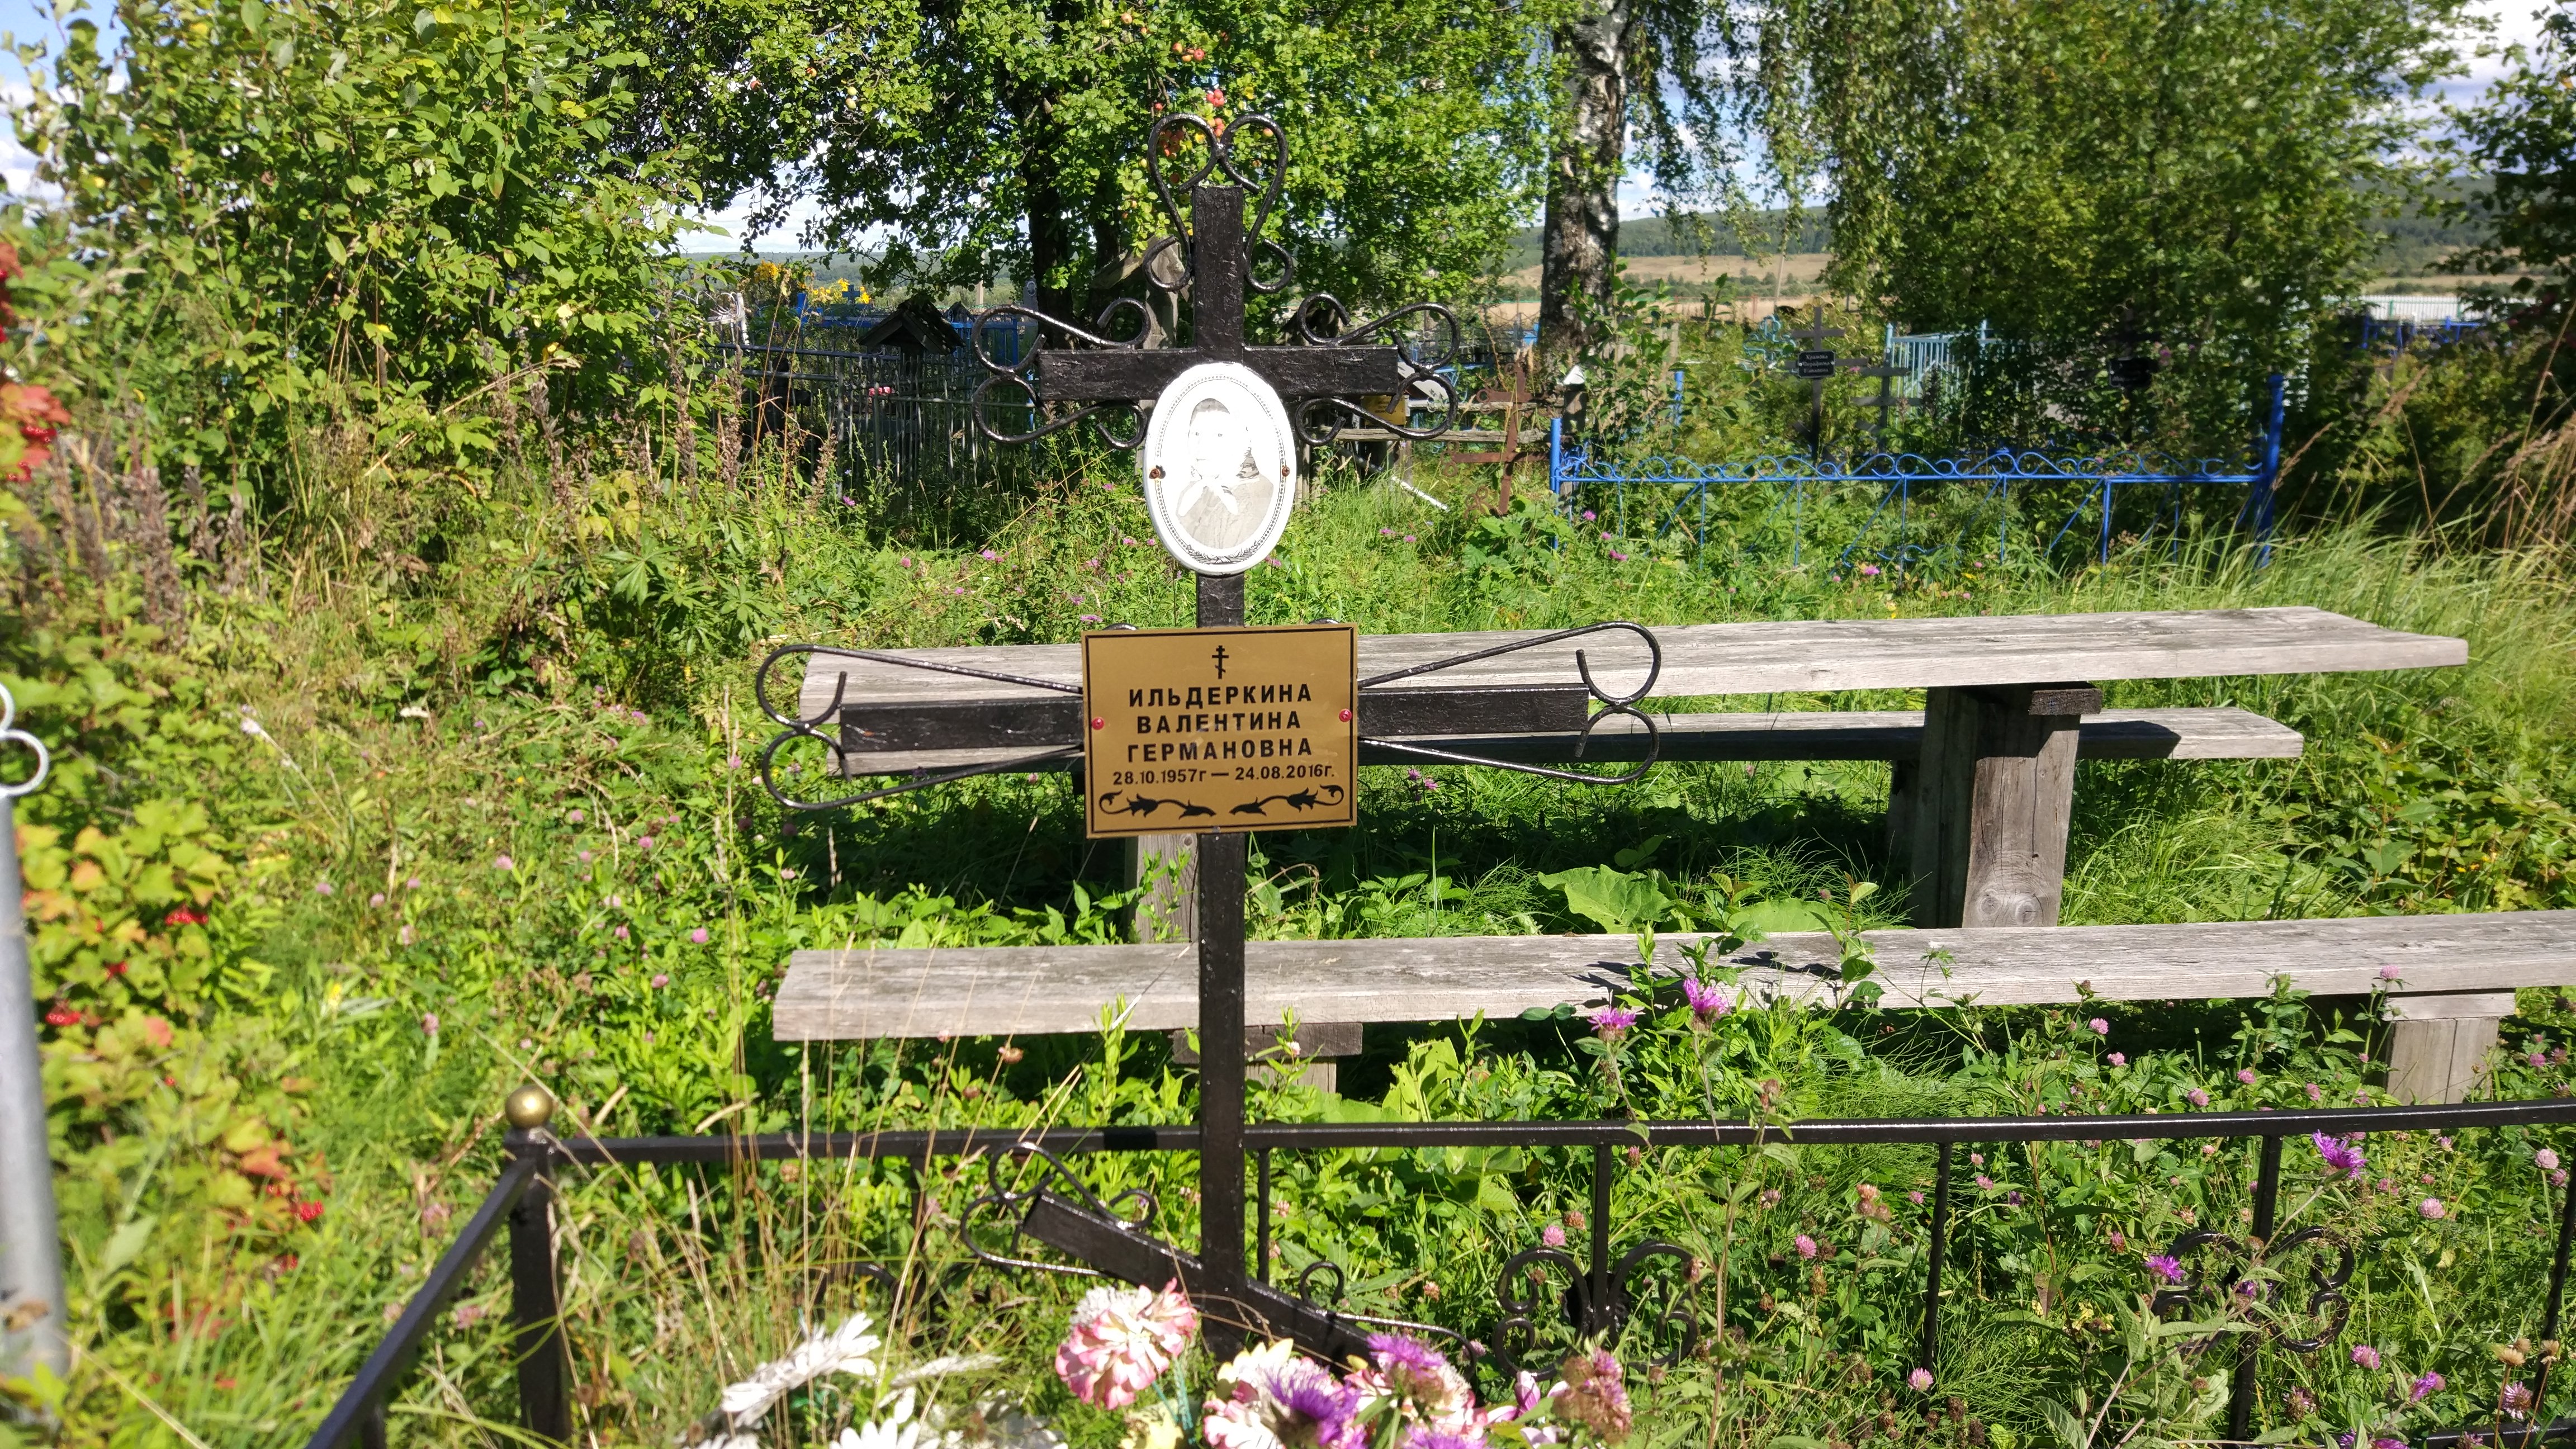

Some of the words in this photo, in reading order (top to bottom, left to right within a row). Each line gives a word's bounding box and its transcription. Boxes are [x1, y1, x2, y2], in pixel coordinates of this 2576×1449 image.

[1129, 683, 1312, 709] ИЛЬДЕРКИНА
[1137, 711, 1301, 734] ВАЛЕНТИНА
[1127, 737, 1313, 763] ГЕРМАНОВНА
[1112, 769, 1207, 785] 28.10.1957г
[1235, 764, 1335, 780] 24.08.2016г.
